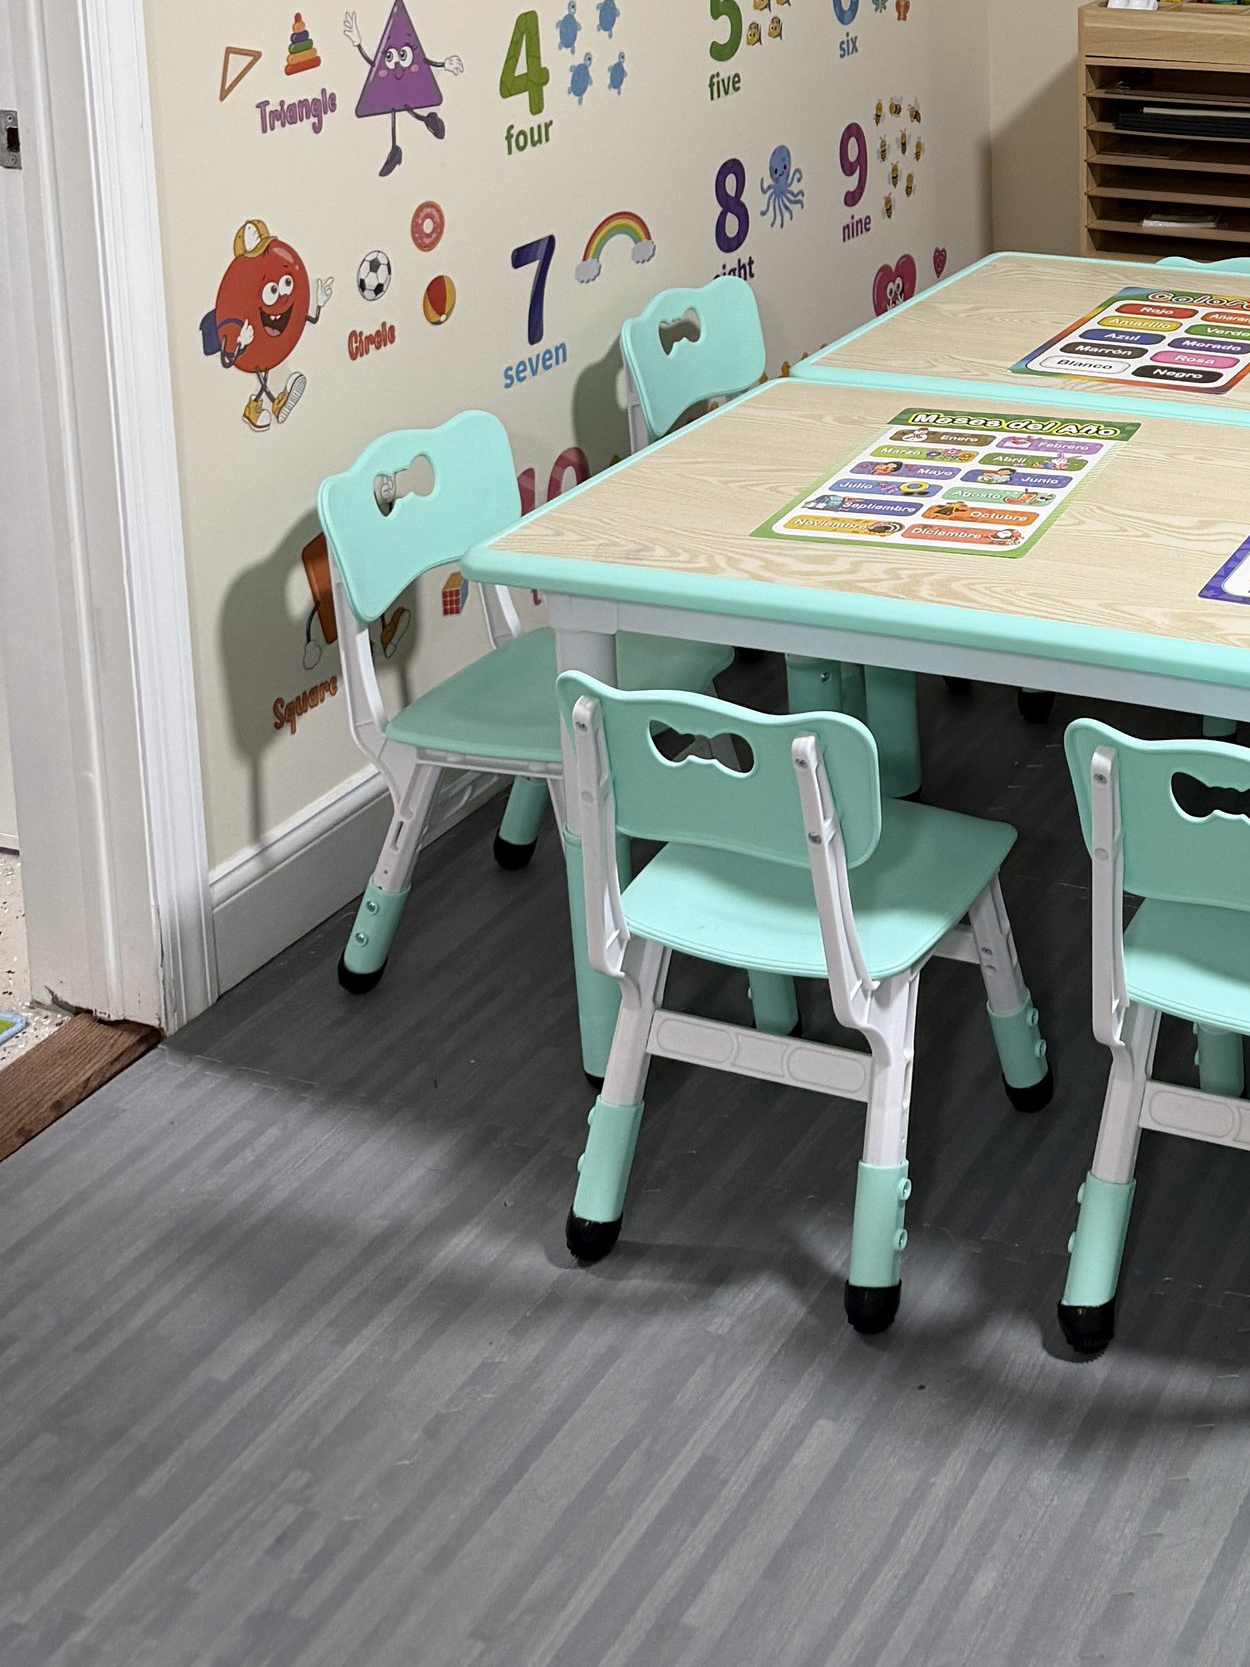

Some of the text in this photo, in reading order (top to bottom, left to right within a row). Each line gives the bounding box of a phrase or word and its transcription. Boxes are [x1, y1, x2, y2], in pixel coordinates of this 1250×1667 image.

[839, 32, 859, 59] six
[499, 10, 550, 116] 4
[708, 71, 741, 101] five
[256, 88, 337, 134] Triangle
[504, 120, 554, 155] four
[839, 122, 868, 207] 9
[714, 158, 750, 253] 8
[842, 214, 872, 243] nine
[511, 234, 556, 346] 7
[1141, 305, 1174, 317] Rojo
[1109, 317, 1172, 330] Amarillo
[1106, 332, 1140, 342] Azul
[1206, 327, 1250, 338] Verde
[348, 321, 396, 361] Circle
[1182, 339, 1241, 352] Morado
[503, 340, 568, 389] seven
[1056, 359, 1114, 370] Blanco
[1174, 354, 1215, 365] Rosa
[1153, 368, 1204, 380] Negro
[910, 411, 1119, 438] Meses del Año
[940, 433, 979, 444] Enero
[880, 446, 921, 457] Marzo
[1038, 440, 1090, 452] Febrero
[992, 454, 1028, 465] Abril
[917, 466, 953, 478] Mayo
[839, 481, 874, 491] Julio
[1020, 475, 1060, 485] Junio
[951, 489, 1003, 501] Agosto
[842, 500, 917, 515] Septiembre
[969, 510, 1029, 523] Octubre
[794, 517, 868, 531] Noviembre
[910, 526, 982, 540] Diciembre
[272, 675, 338, 734] Square
